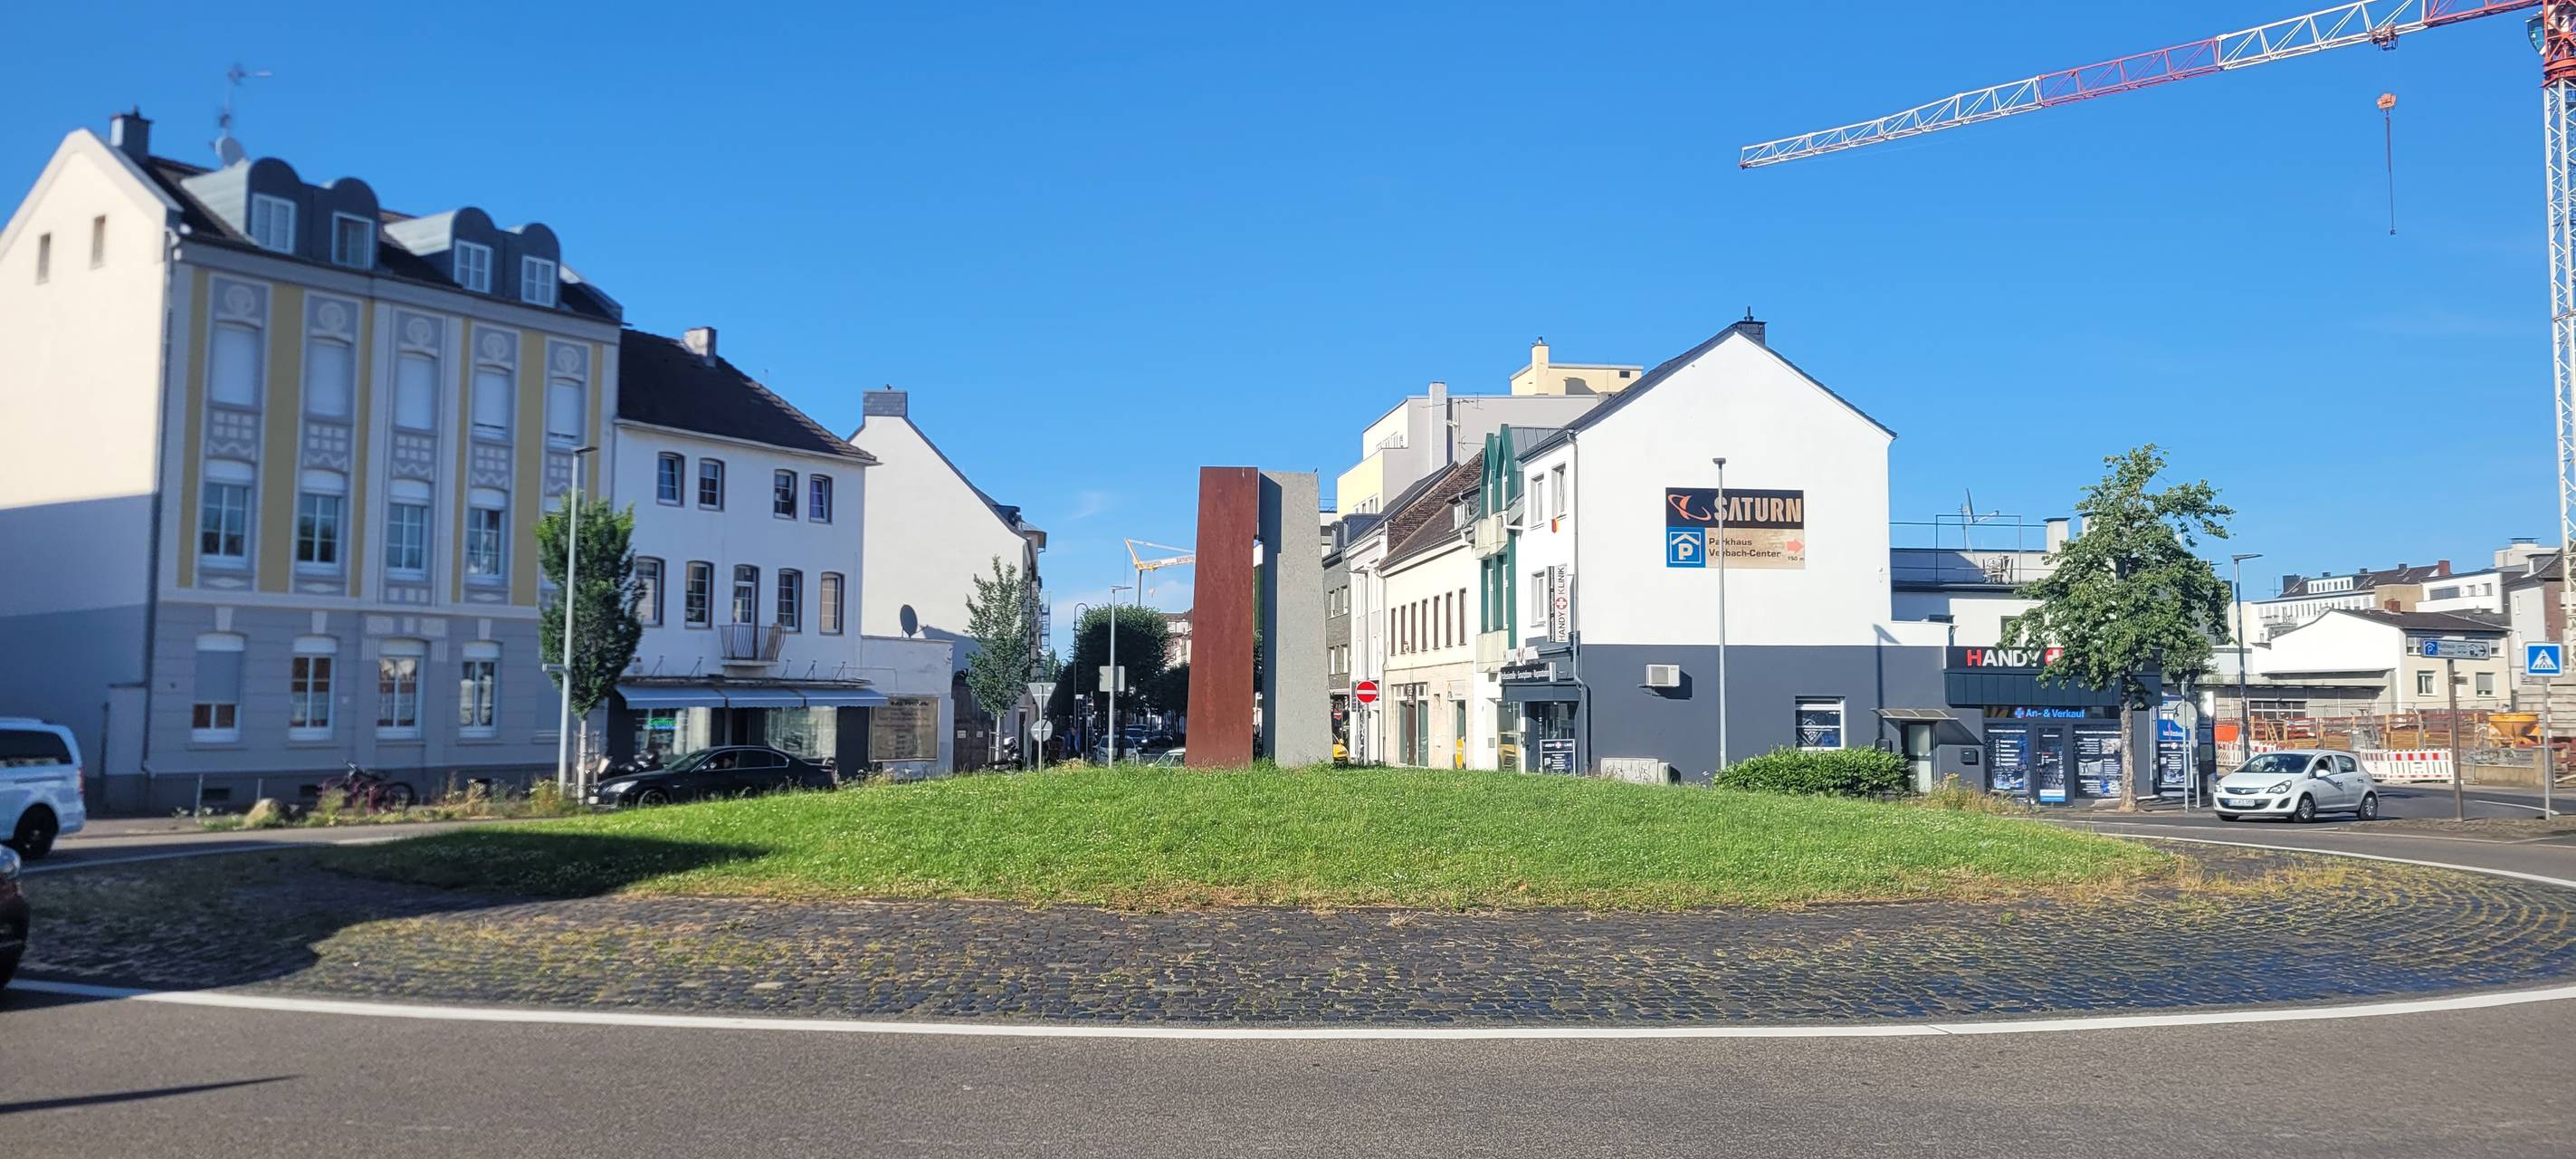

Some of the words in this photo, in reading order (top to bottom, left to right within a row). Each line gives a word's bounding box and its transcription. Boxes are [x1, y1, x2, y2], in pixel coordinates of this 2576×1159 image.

[1714, 497, 1802, 522] SATURN
[2026, 709, 2042, 718] An-
[2043, 709, 2051, 718] &
[2051, 709, 2085, 718] Verkauf
